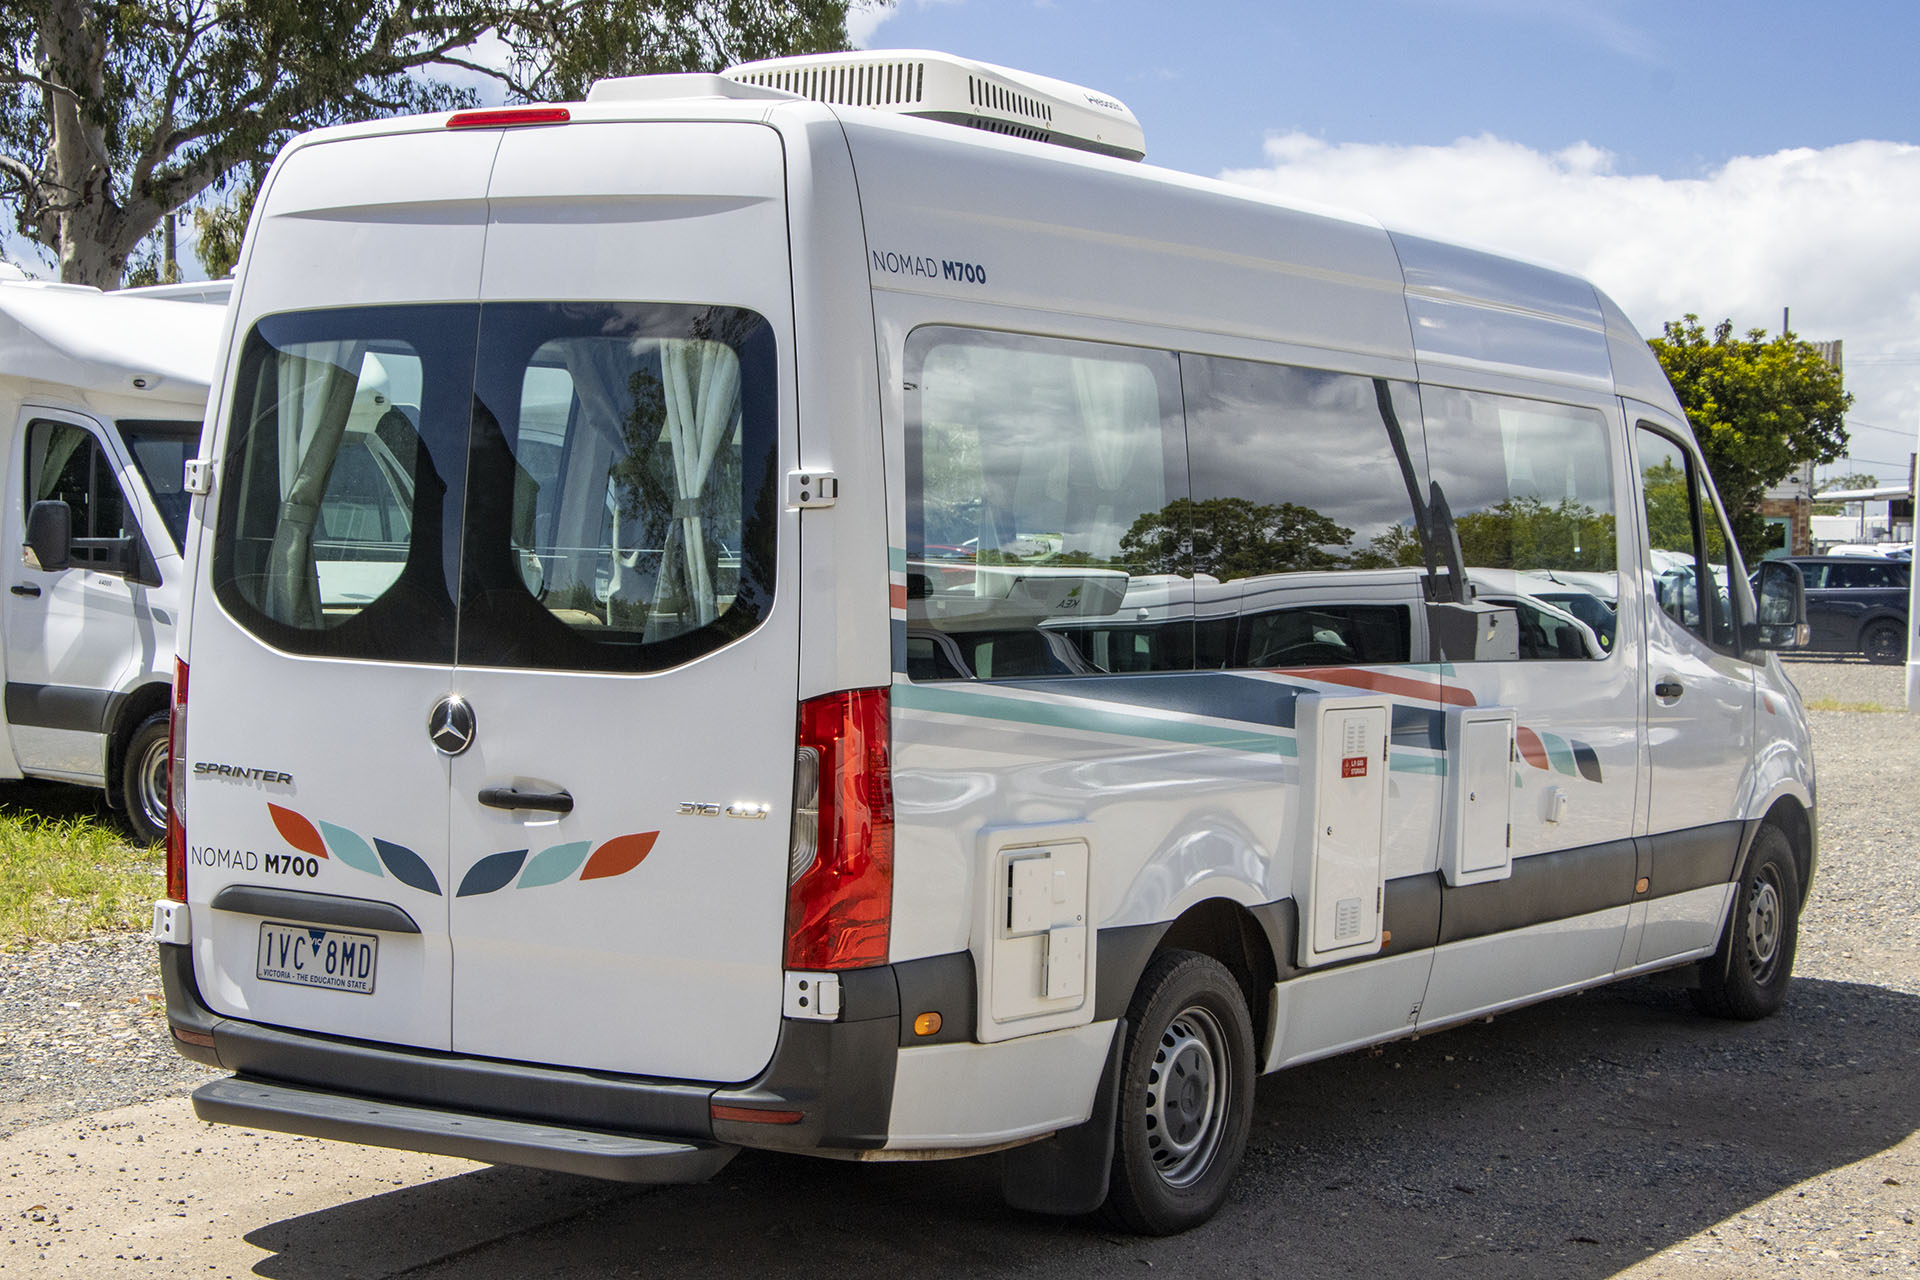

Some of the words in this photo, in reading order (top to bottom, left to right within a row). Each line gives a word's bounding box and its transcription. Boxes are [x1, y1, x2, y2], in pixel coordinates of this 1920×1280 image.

[872, 250, 938, 278] NOMAD
[942, 260, 986, 284] M700
[193, 762, 293, 784] SPRINTER
[191, 846, 258, 871] NOMAD
[265, 853, 319, 877] M700
[326, 940, 371, 979] 8MD
[263, 968, 291, 979] VICTORIA
[297, 973, 309, 982] THE
[310, 975, 346, 987] EDUCATION
[347, 980, 366, 990] STATE
